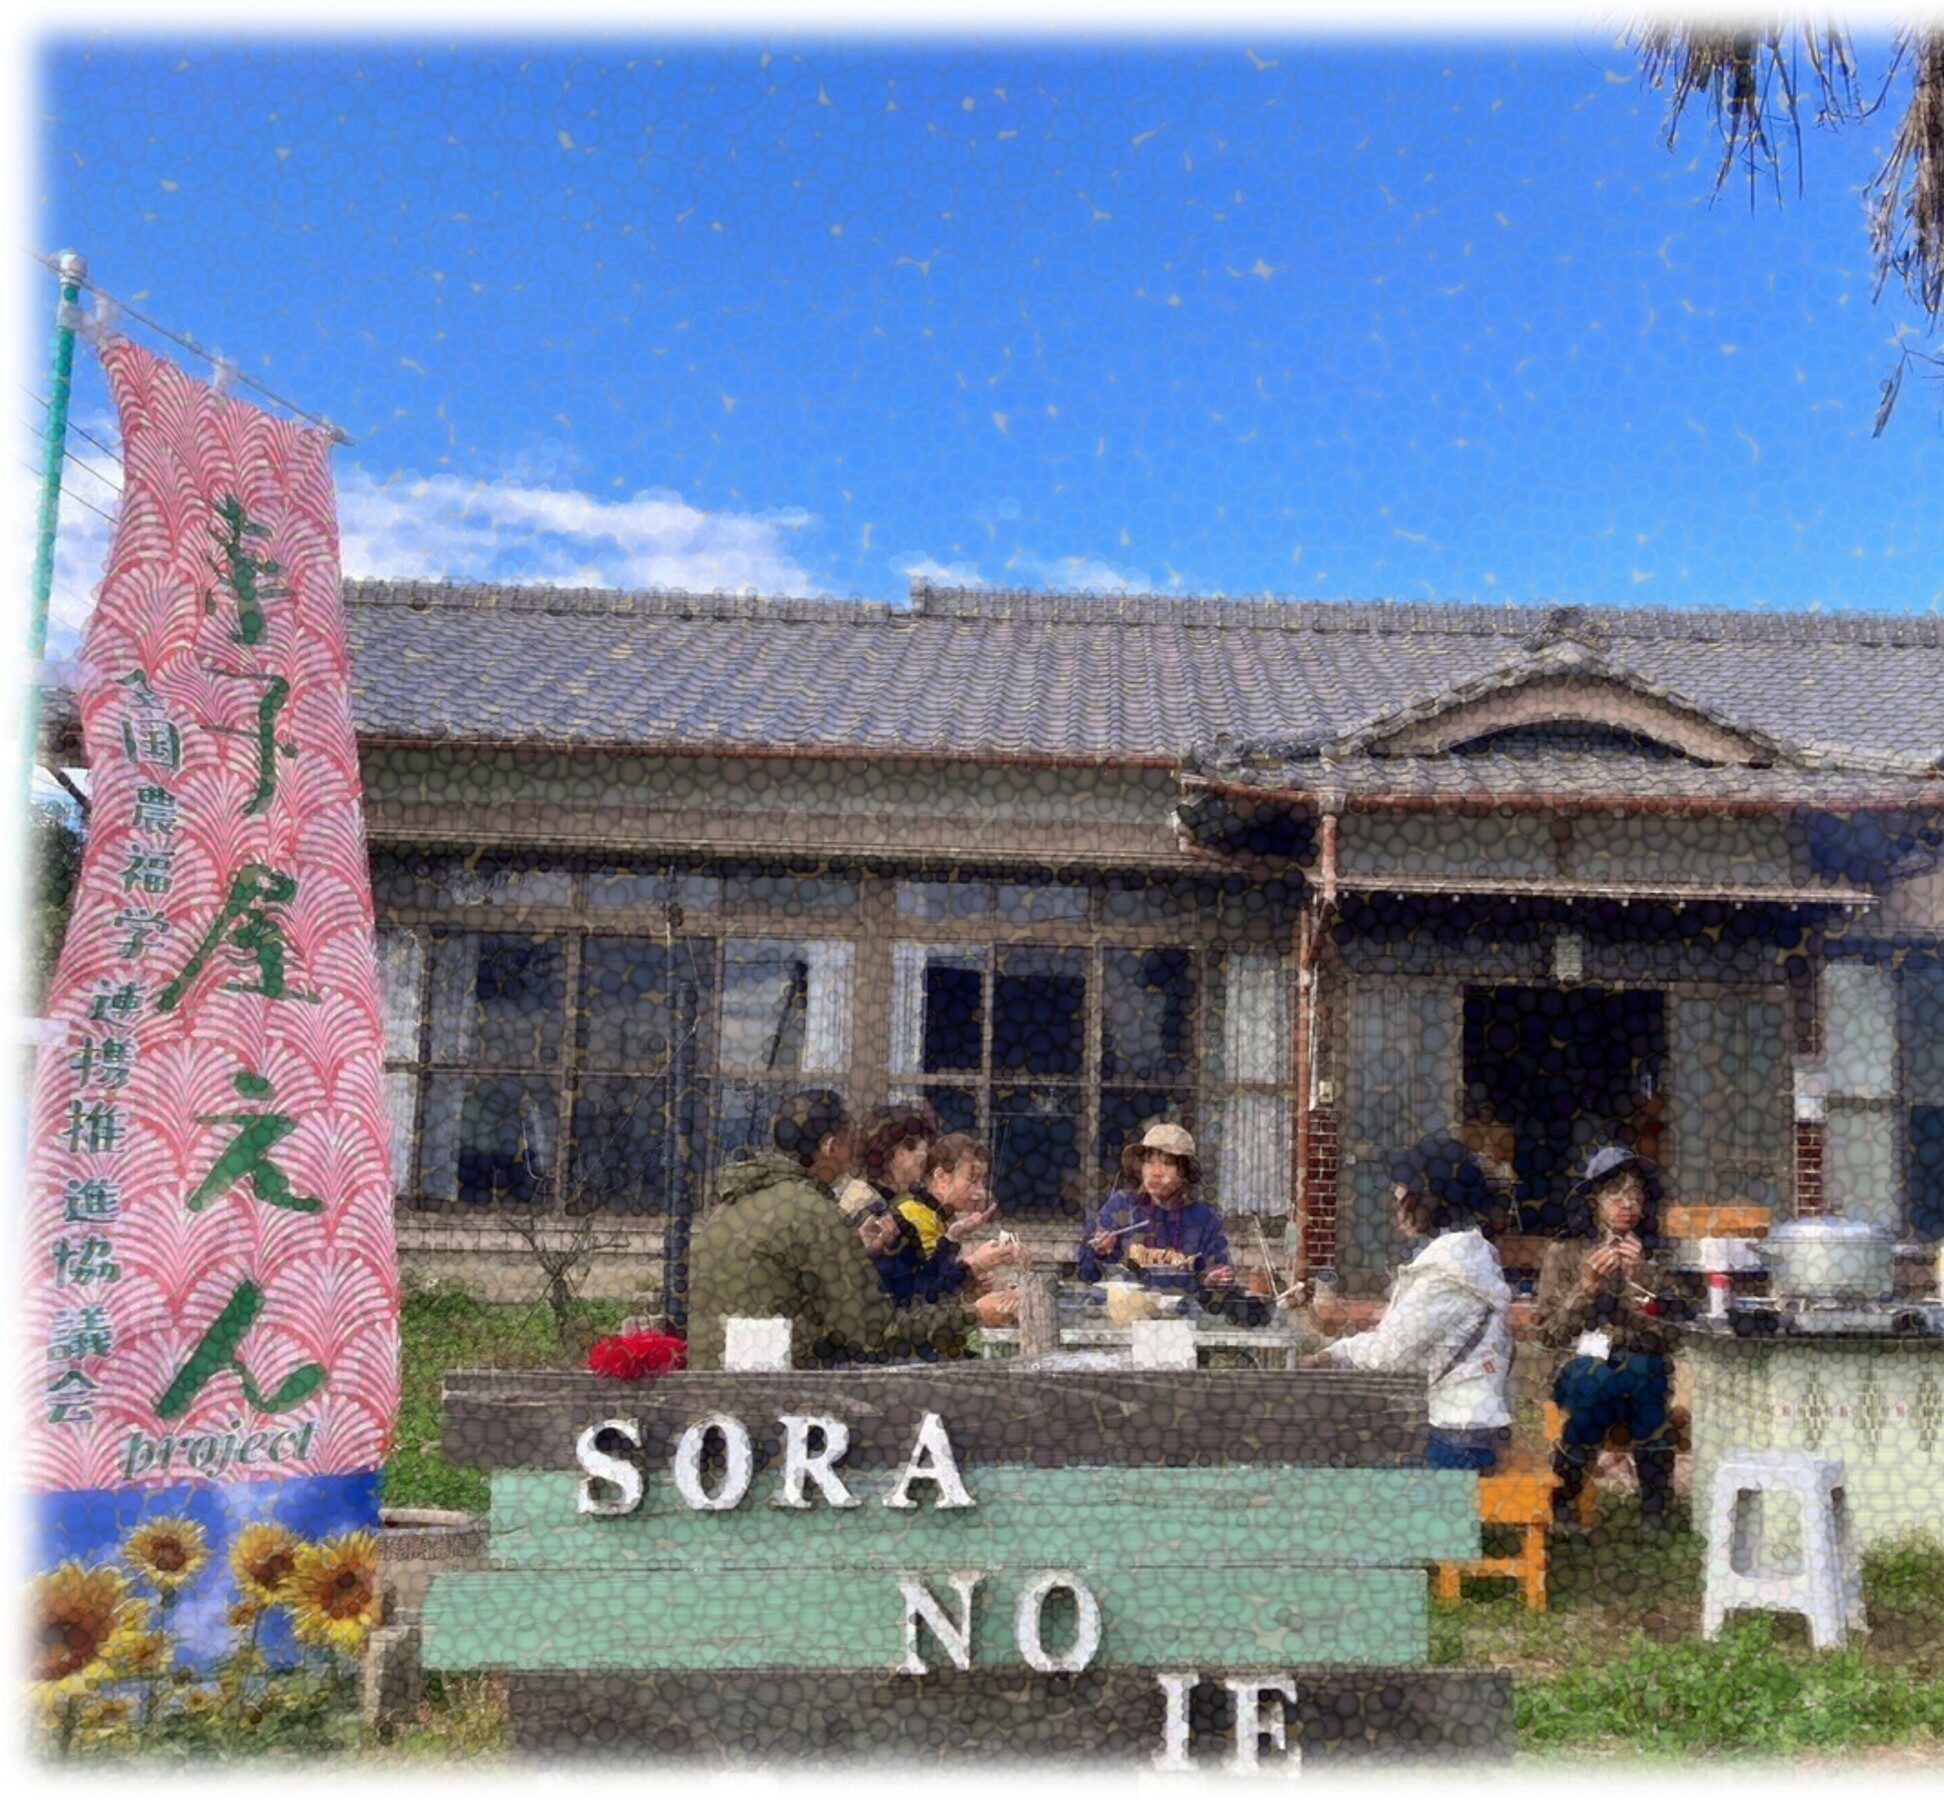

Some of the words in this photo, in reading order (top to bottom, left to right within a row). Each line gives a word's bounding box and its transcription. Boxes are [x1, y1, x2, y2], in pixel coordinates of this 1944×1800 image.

[122, 1420, 315, 1479] project
[575, 1411, 976, 1515] SORA
[897, 1569, 1104, 1676] NO
[1152, 1673, 1302, 1777] IE
